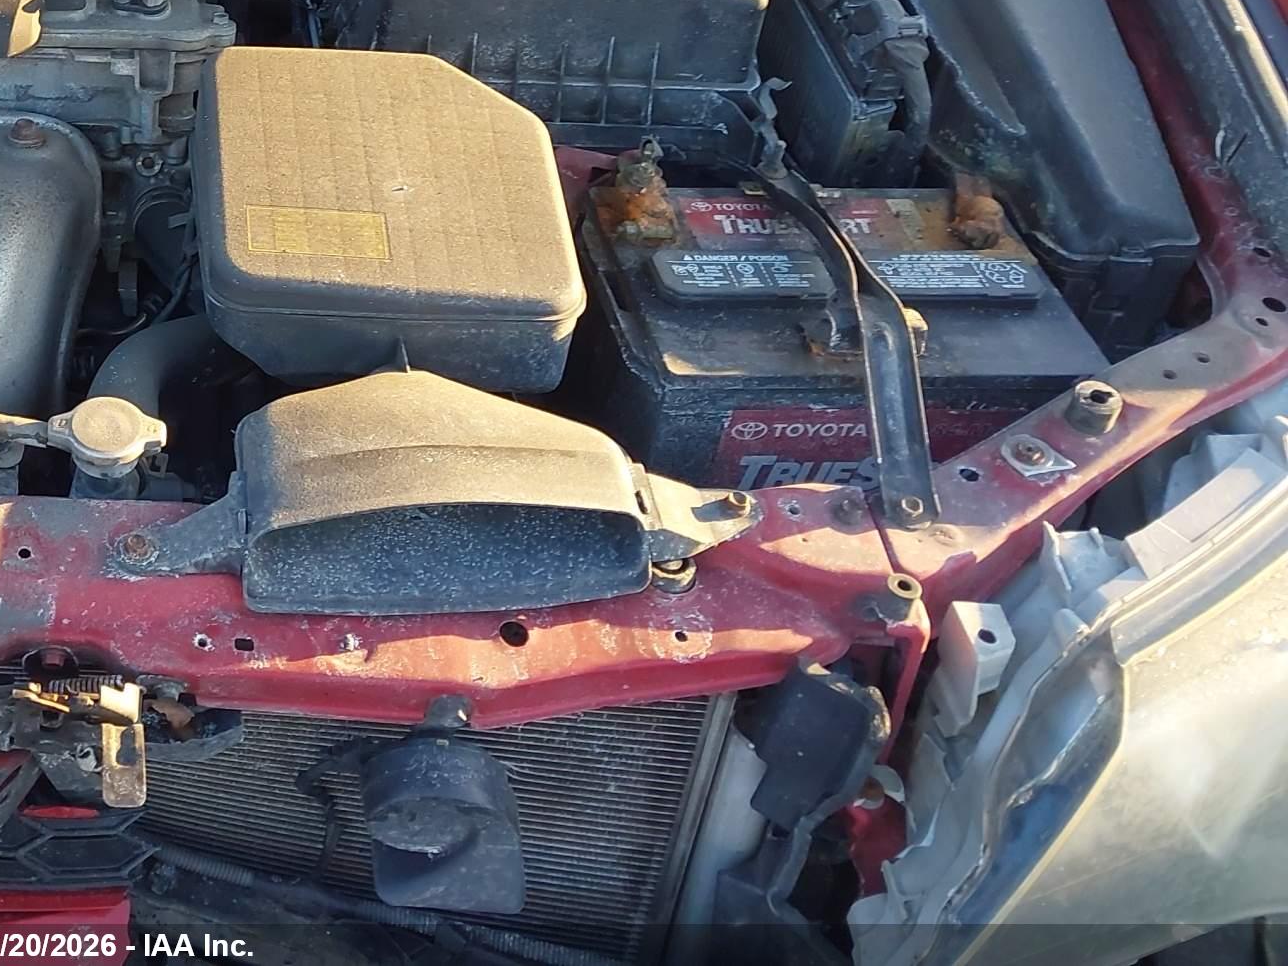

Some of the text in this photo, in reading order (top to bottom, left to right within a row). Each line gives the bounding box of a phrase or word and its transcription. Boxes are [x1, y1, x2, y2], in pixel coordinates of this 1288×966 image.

[713, 203, 772, 211] TOYOTA
[694, 254, 738, 262] DANGER
[773, 423, 867, 437] TOYOTA
